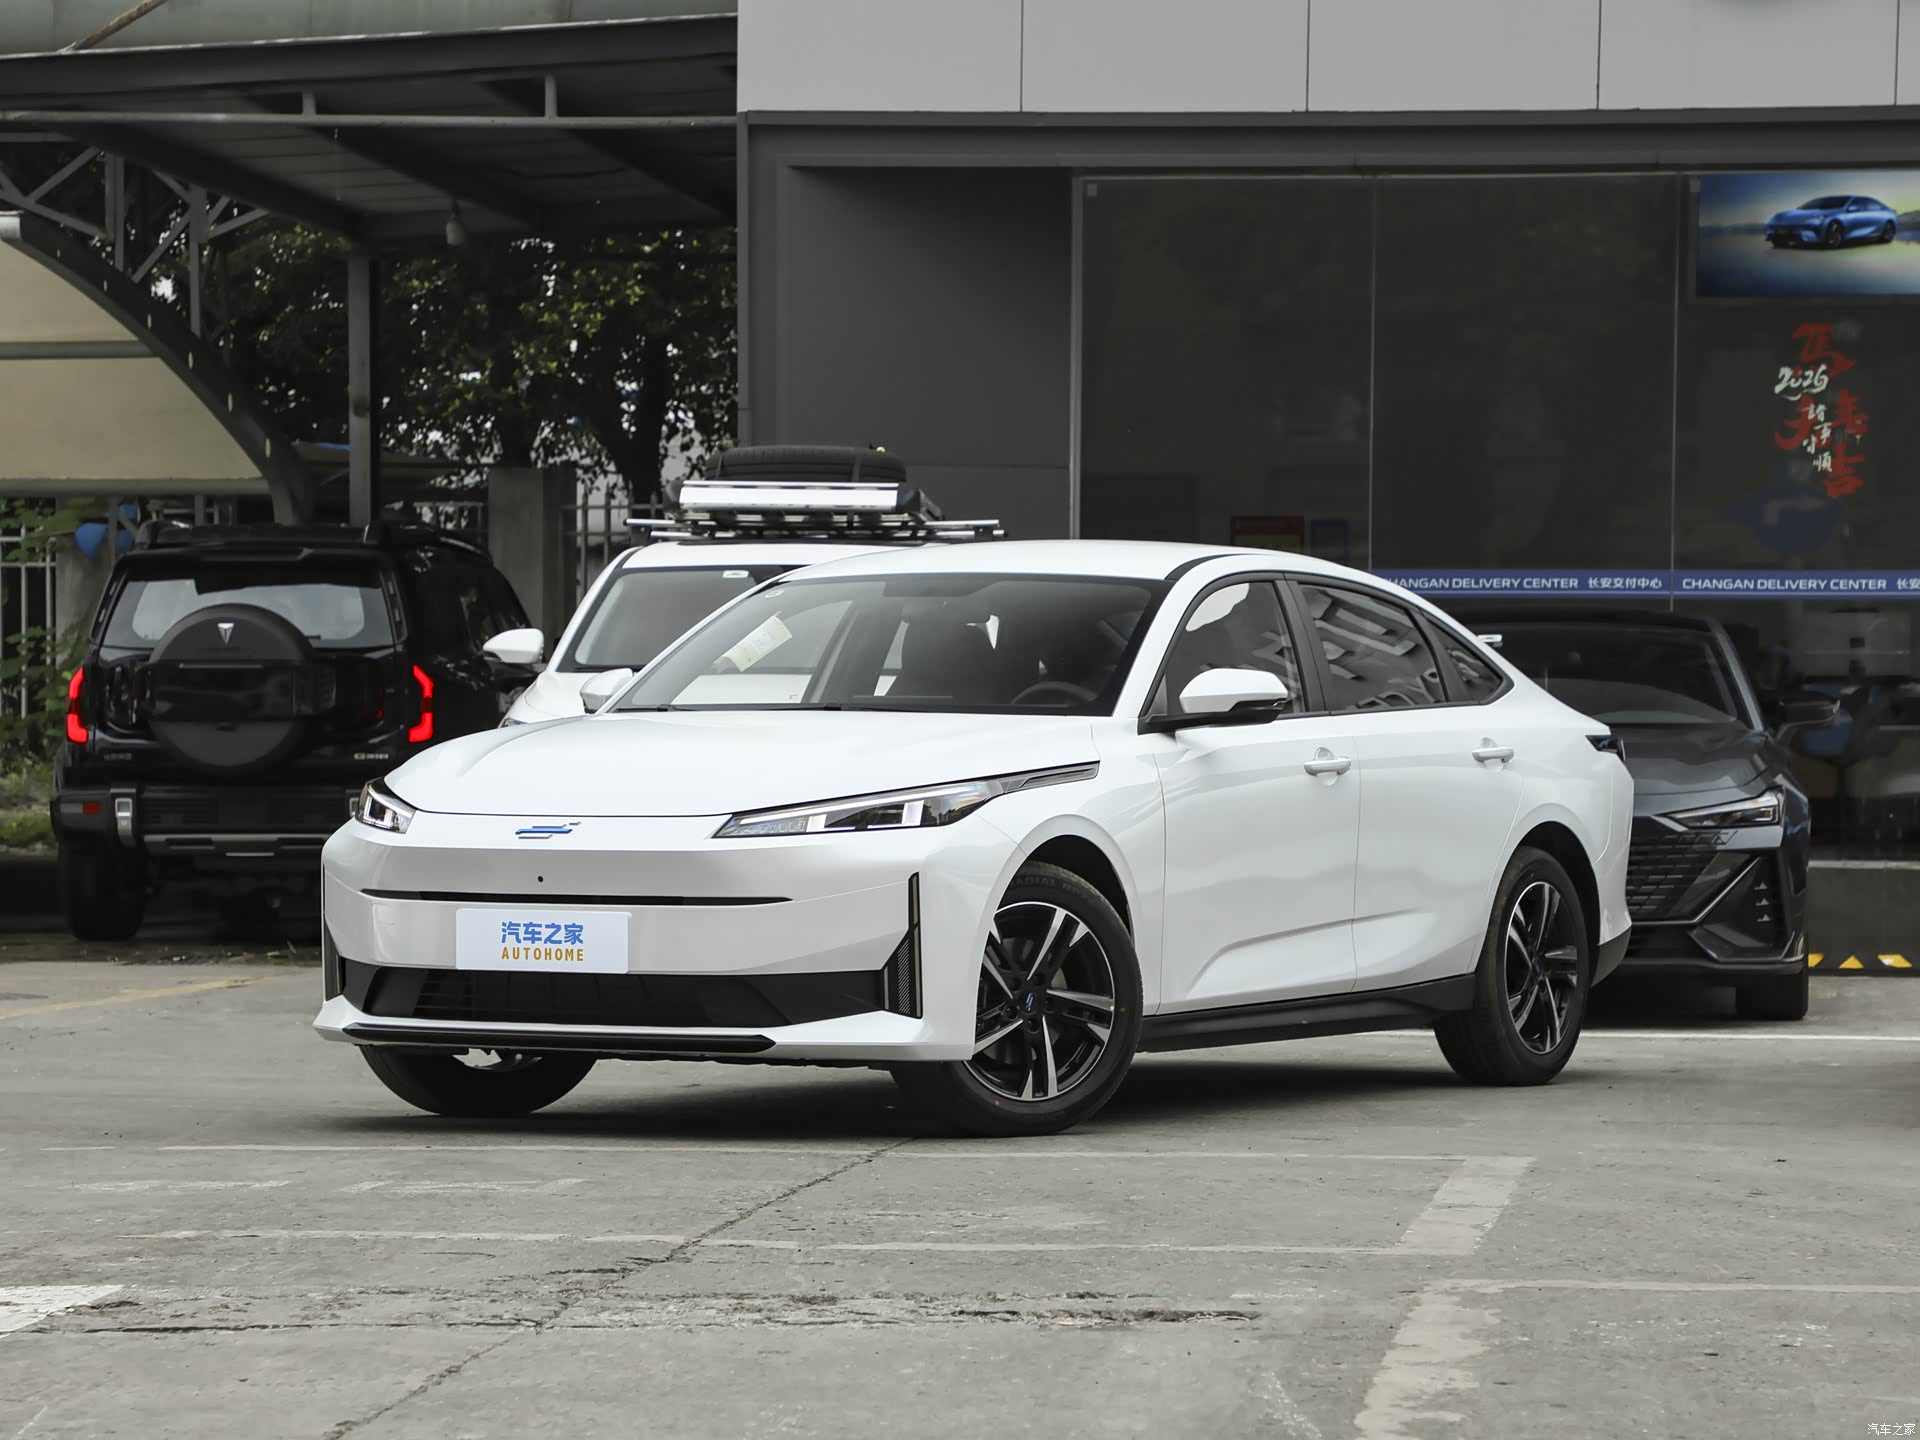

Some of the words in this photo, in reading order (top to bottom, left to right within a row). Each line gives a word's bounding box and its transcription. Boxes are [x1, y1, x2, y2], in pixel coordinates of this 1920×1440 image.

[1774, 364, 1829, 401] 2026
[1387, 577, 1449, 589] ANGAN
[1452, 578, 1520, 589] DELIVERY
[1523, 578, 1579, 589] CENTER
[1588, 577, 1662, 590] 长安交付中心
[1682, 578, 1755, 590] CHANGAN
[1757, 579, 1828, 590] DELIVERY
[1830, 579, 1887, 590] CENTER
[501, 921, 584, 945] 汽车之家
[501, 947, 584, 962] AUTOHOME
